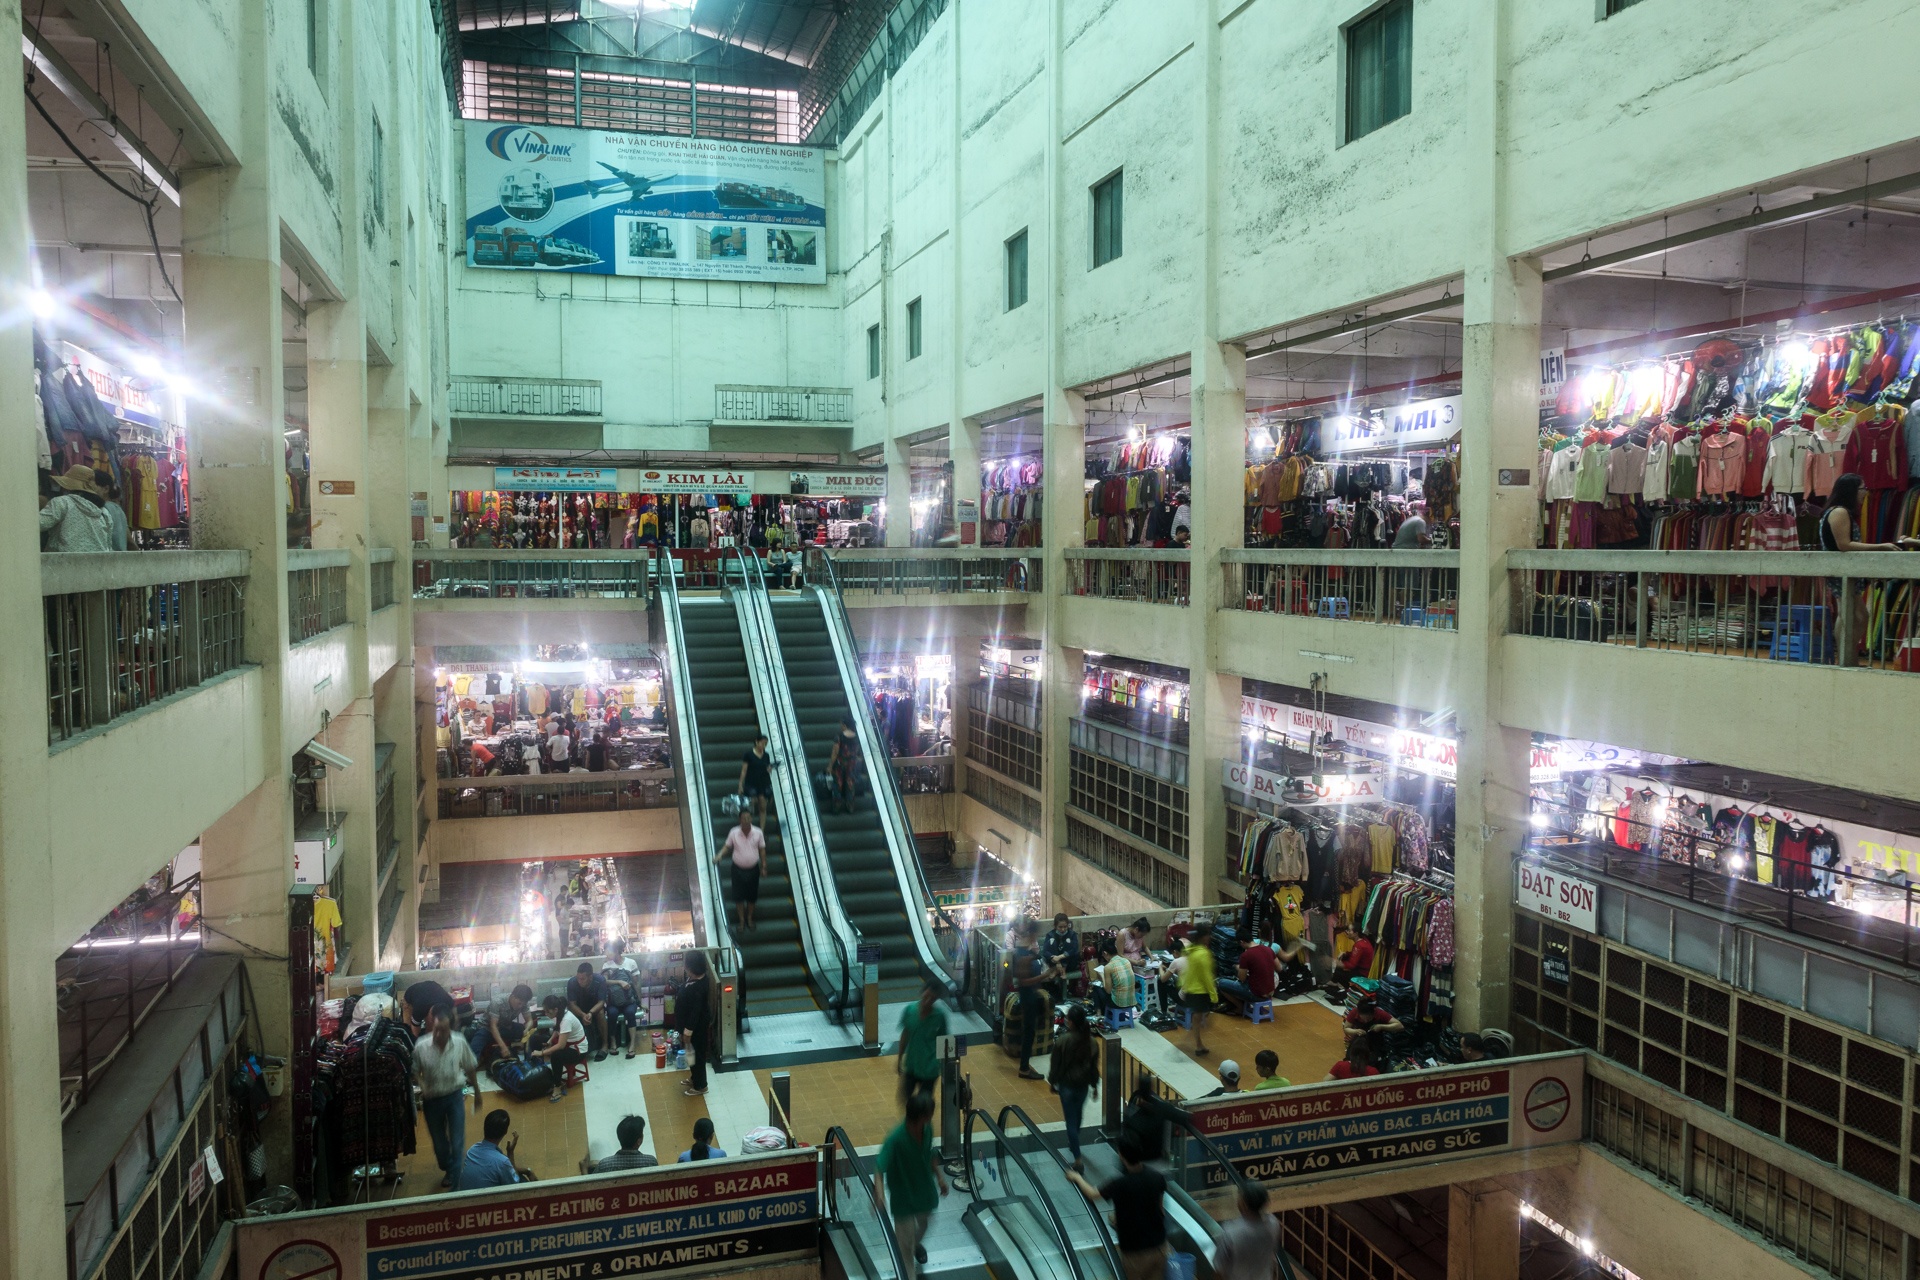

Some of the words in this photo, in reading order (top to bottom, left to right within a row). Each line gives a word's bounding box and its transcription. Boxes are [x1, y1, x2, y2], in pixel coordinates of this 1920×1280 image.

[514, 132, 572, 157] VINALINK
[605, 134, 625, 145] NHÀ
[627, 136, 647, 148] VẬN
[649, 138, 688, 150] CHUYỂN
[690, 140, 717, 152] HÀNG
[719, 143, 739, 153] HÓA
[740, 145, 778, 156] CHUYÊN
[780, 148, 813, 159] NGHIỆP
[1540, 350, 1564, 385] LIÊN
[667, 473, 706, 484] KIM
[712, 472, 744, 485] LÀI
[826, 476, 852, 486] MAI
[854, 475, 884, 486] ĐỨC
[465, 663, 488, 672] THANH
[1260, 705, 1278, 722] VY
[1293, 711, 1314, 729] KHÁNH
[1345, 723, 1367, 745] YẾN
[1230, 767, 1249, 786] CÔ
[1254, 774, 1276, 796] BA
[1521, 868, 1555, 899] ĐẠT
[1560, 880, 1594, 913] SƠN
[1540, 904, 1552, 916] B61
[1558, 910, 1571, 922] B62
[1206, 1113, 1229, 1130] tầng
[1259, 1103, 1298, 1121] VÀNG
[1302, 1100, 1332, 1116] BẠC
[1341, 1093, 1362, 1110] ĂN
[1366, 1087, 1405, 1107] UỐNG
[1416, 1083, 1456, 1100] CHẠP
[1460, 1076, 1491, 1094] PHÔ
[1239, 1132, 1263, 1151] VẢI
[1271, 1130, 1294, 1147] MỸ
[1297, 1122, 1337, 1143] PHẨM
[1341, 1120, 1379, 1137] VÀNG
[1384, 1115, 1413, 1131] BẠC
[1421, 1107, 1460, 1126] BÁCH
[1465, 1103, 1494, 1119] HÓA
[1245, 1156, 1297, 1180] QUẦN
[1302, 1152, 1330, 1170] ÁO
[1336, 1148, 1361, 1164] VÀ
[1368, 1140, 1437, 1159] TRANG
[1444, 1129, 1481, 1149] SỨC
[455, 1206, 538, 1230] JEWELRY
[550, 1196, 605, 1218] EATING
[610, 1197, 621, 1210] &
[628, 1185, 699, 1207] DRINKING
[714, 1172, 789, 1196] BAZAAR
[377, 1252, 433, 1273] Ground
[478, 1239, 524, 1260] CLOTH
[531, 1227, 613, 1252] PERFUMERY
[618, 1217, 684, 1240] JEWELRY
[688, 1215, 715, 1230] ALL
[718, 1209, 746, 1226] KIND
[748, 1206, 763, 1221] OF
[766, 1200, 807, 1218] GOODS
[591, 1262, 604, 1275] &
[610, 1239, 750, 1272] ORNAMENTS
